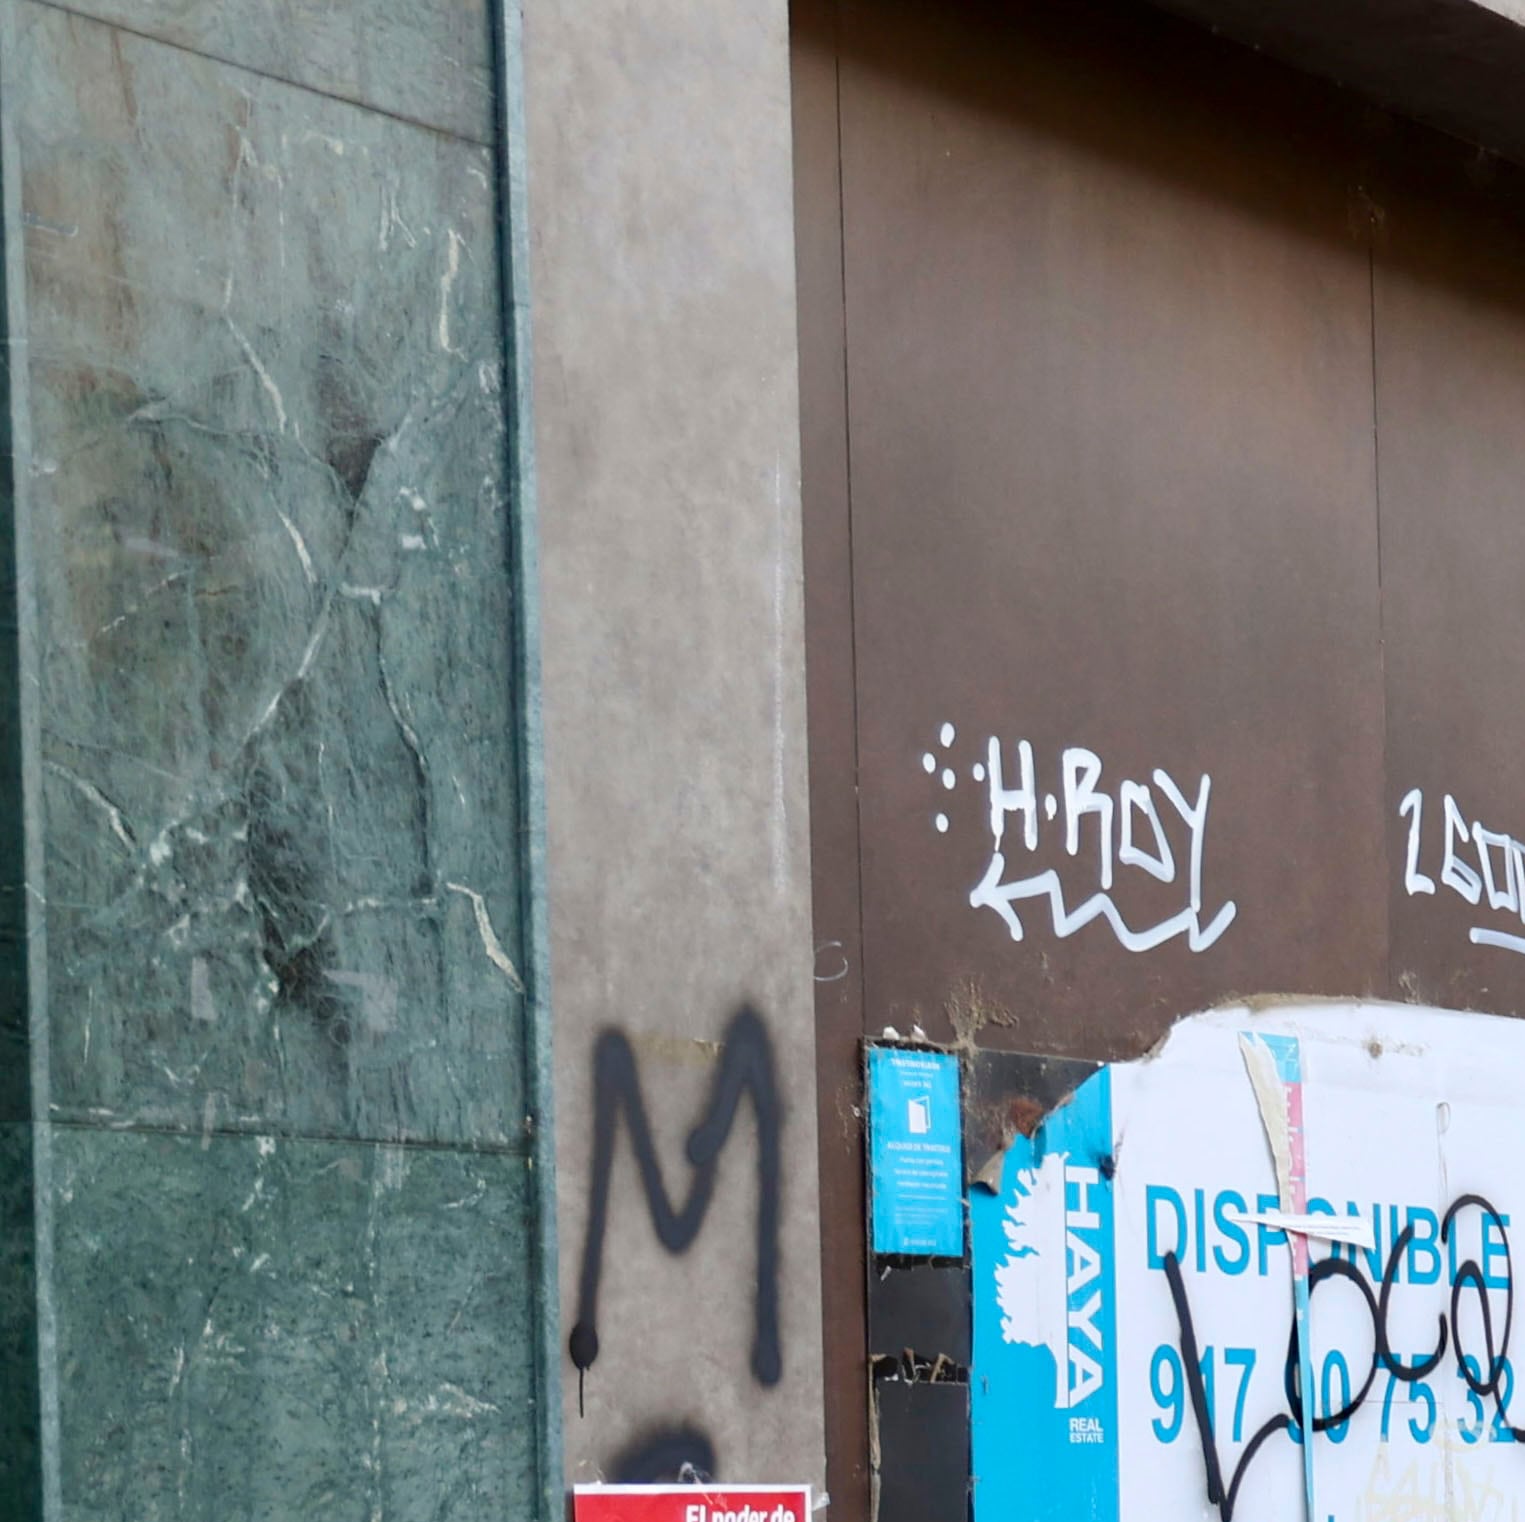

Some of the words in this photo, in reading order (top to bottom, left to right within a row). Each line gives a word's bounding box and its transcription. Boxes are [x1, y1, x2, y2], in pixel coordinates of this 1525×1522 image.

[570, 1005, 782, 1390] M
[1064, 1165, 1103, 1410] HAYA
[1069, 1417, 1102, 1433] REAL
[1069, 1433, 1104, 1445] ESTATE
[1457, 1354, 1515, 1446] 32
